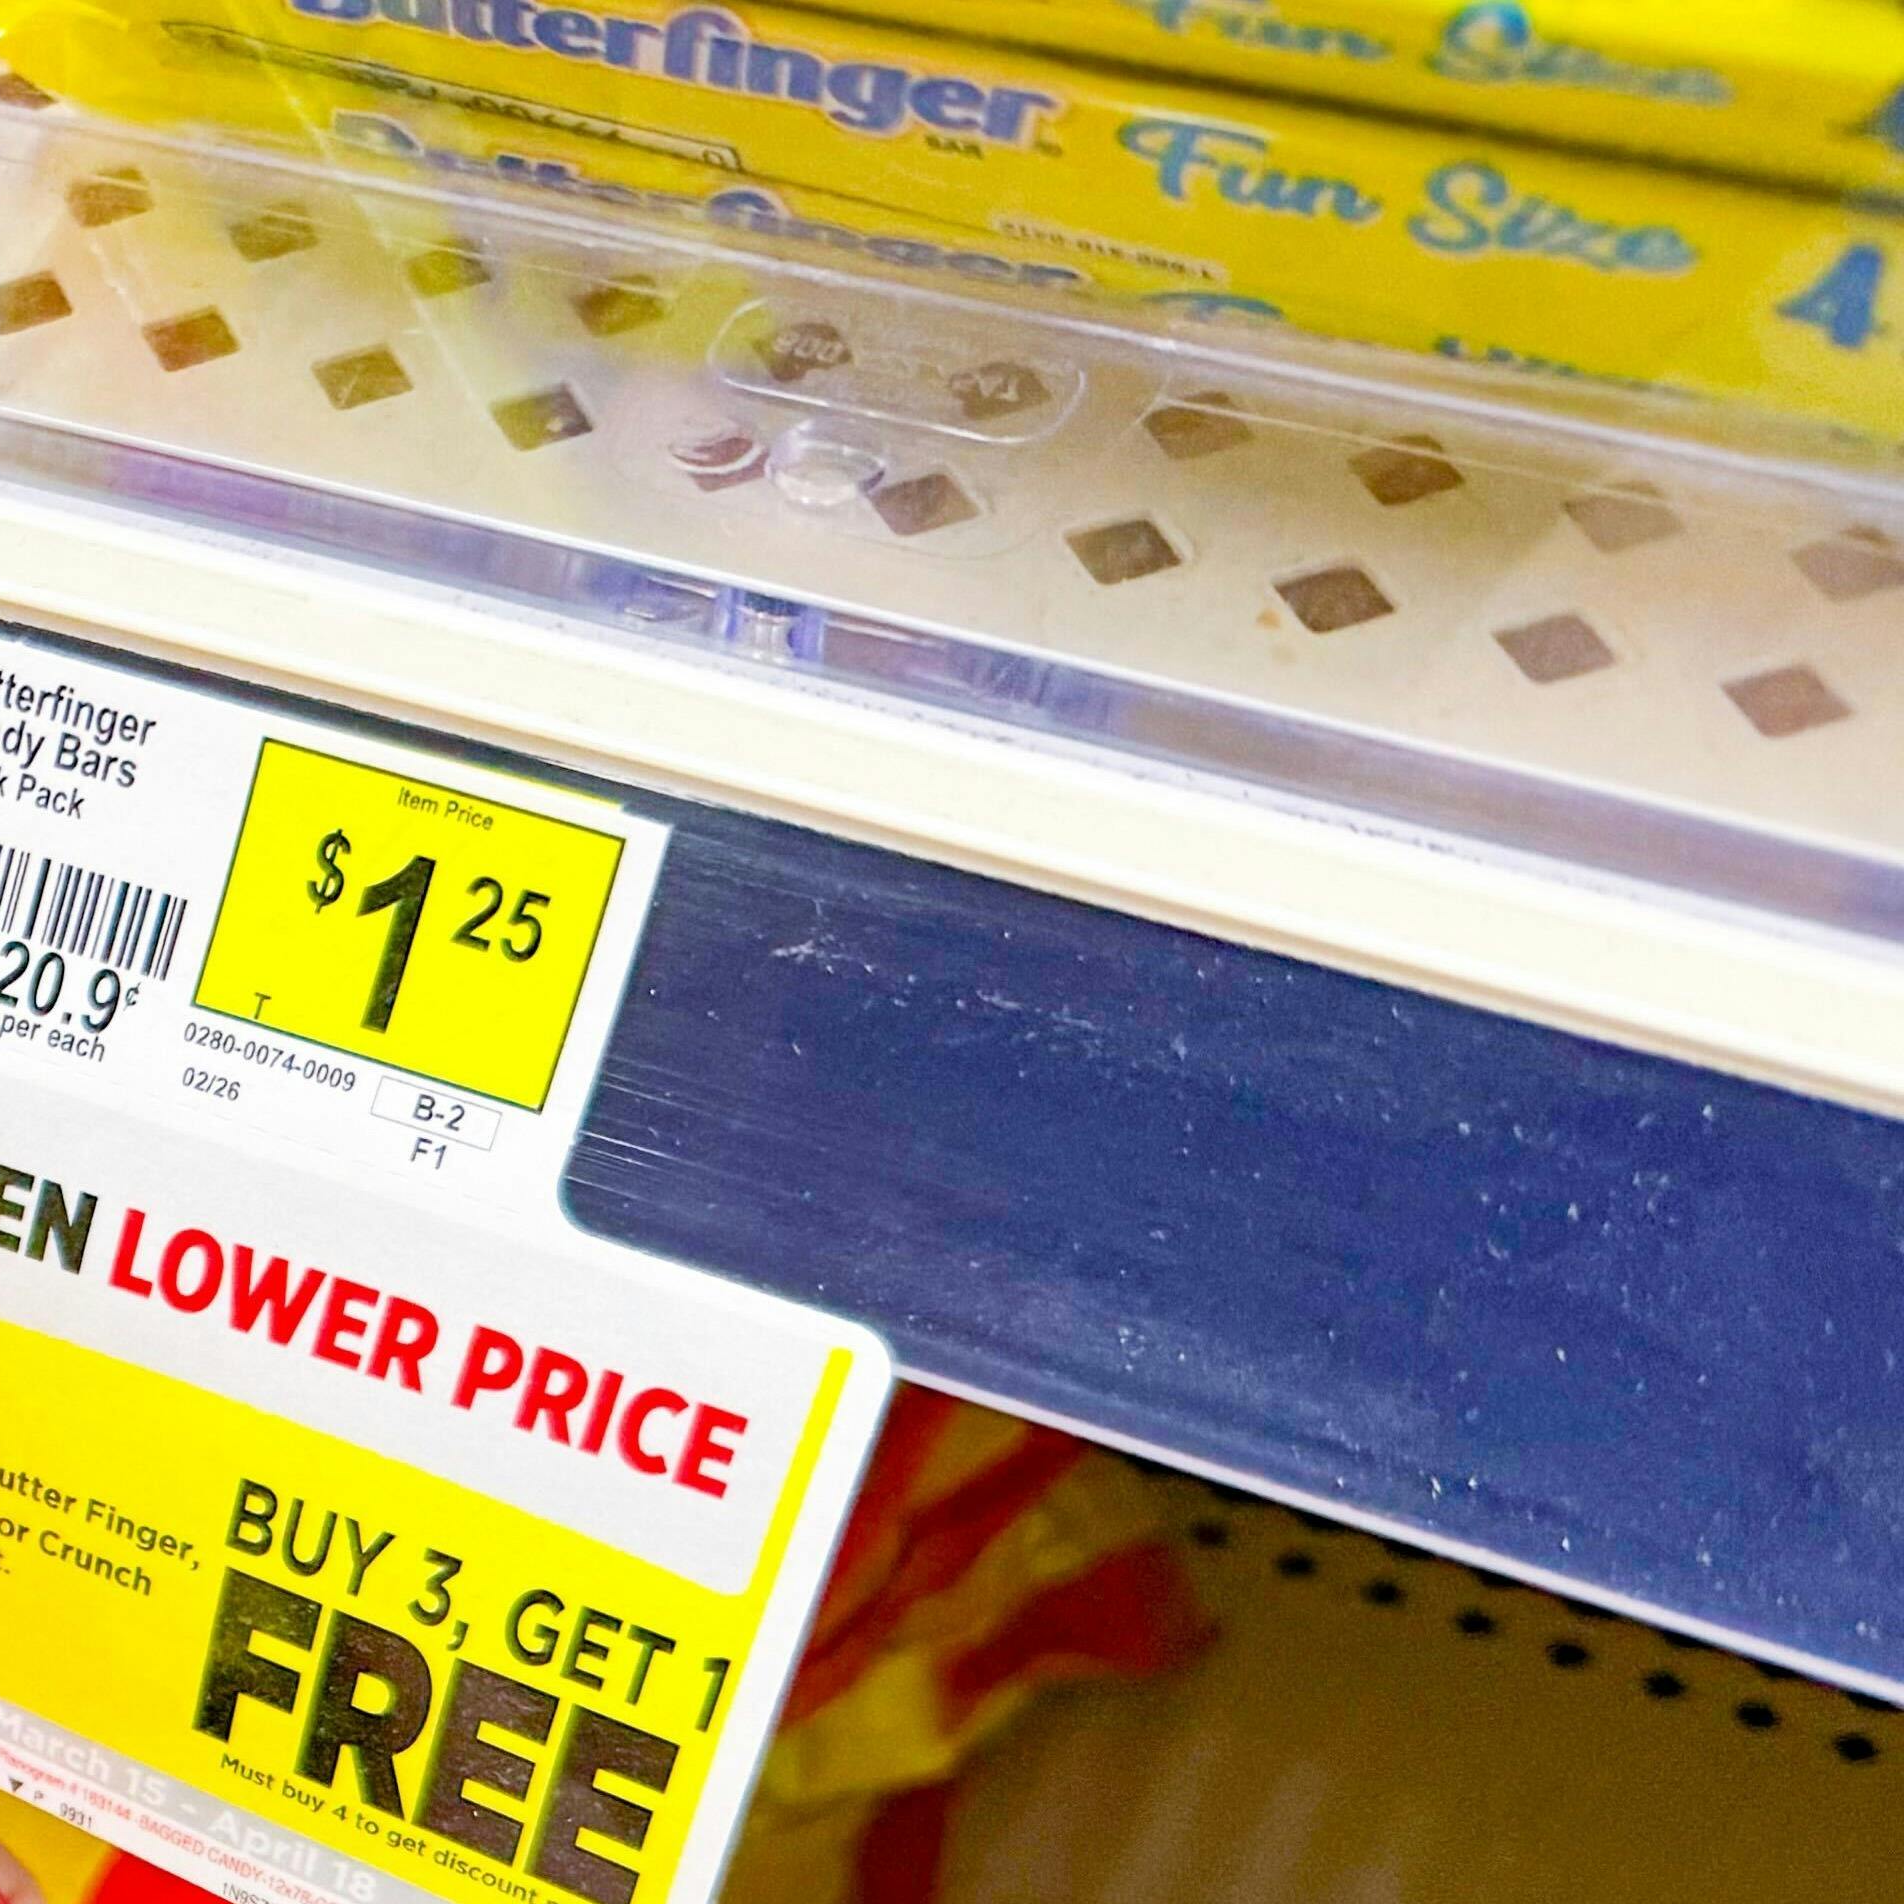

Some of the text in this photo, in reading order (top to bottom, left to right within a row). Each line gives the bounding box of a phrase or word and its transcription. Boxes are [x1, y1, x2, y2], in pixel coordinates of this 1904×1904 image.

[289, 0, 1061, 147] utterfinger
[1117, 116, 1382, 223] Fun
[1776, 244, 1882, 349] 4
[19, 772, 84, 818] Pack
[55, 739, 136, 788] Bars
[398, 786, 494, 832] Item Price
[253, 992, 271, 1020] T
[48, 1028, 106, 1063] each
[183, 1021, 356, 1093] 0280-0074-0009
[183, 1068, 240, 1103] 02/26
[412, 1095, 465, 1132] B-2
[411, 1138, 447, 1170] F1
[108, 1207, 440, 1392] LOWER
[451, 1325, 747, 1499] PRICE
[38, 1530, 152, 1596] Crunch
[86, 1498, 201, 1571] Finger,
[226, 1478, 732, 1733] BUY 3, GET 1
[60, 1802, 94, 1829] 9931
[127, 1767, 169, 1807] 15
[207, 1811, 318, 1875] April
[332, 1864, 377, 1900] 18
[220, 1752, 275, 1791] Must
[282, 1780, 325, 1813] buy
[332, 1804, 347, 1822] 4
[355, 1813, 380, 1836] to
[387, 1830, 427, 1857] get
